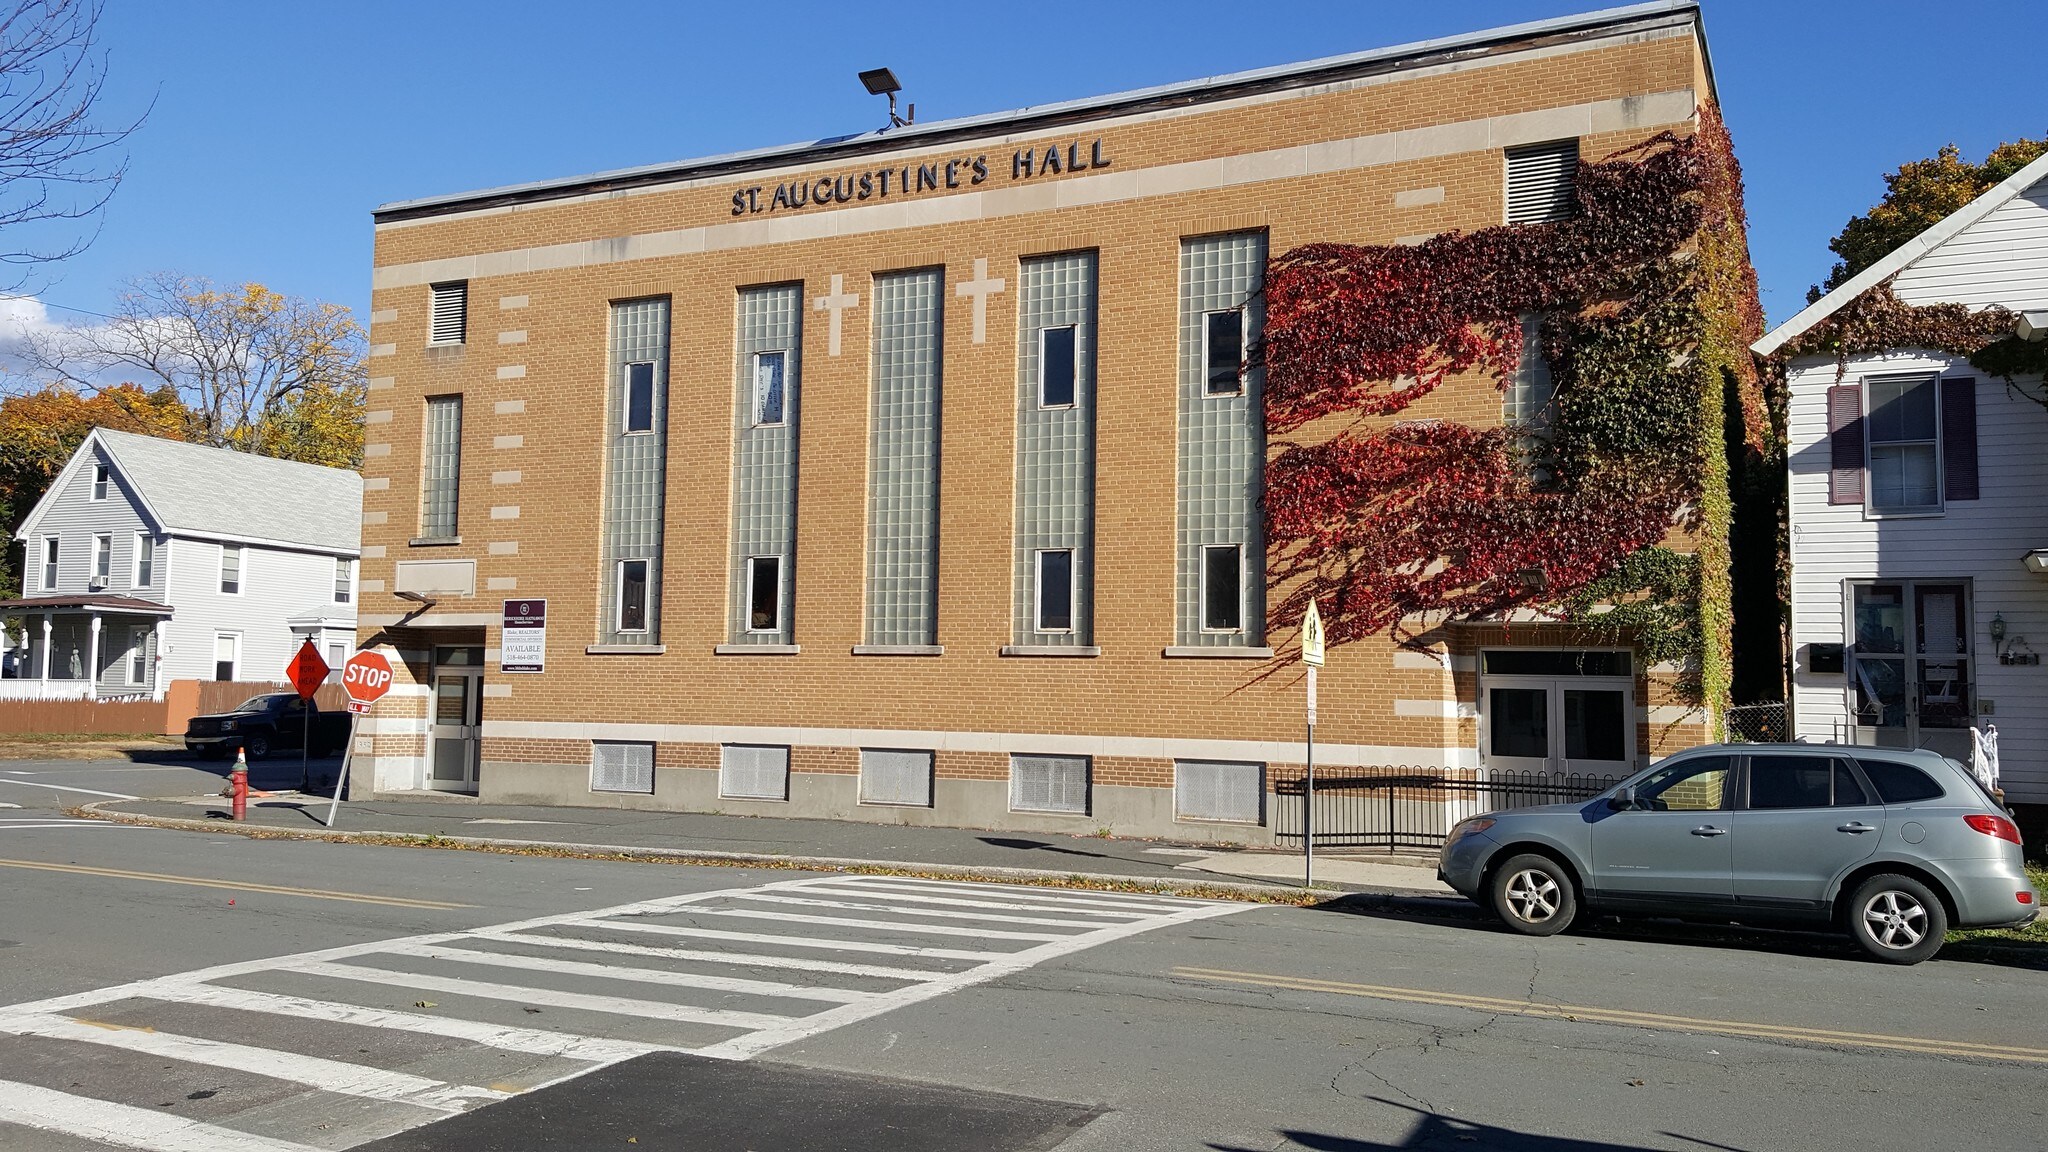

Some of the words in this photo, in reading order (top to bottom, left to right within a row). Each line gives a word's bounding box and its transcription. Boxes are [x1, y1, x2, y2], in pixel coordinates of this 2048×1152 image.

[732, 187, 763, 216] ST.
[770, 155, 989, 211] AUGUSTINE'S
[1012, 138, 1112, 180] HALL
[300, 654, 317, 662] ROAD
[346, 664, 390, 688] STOP
